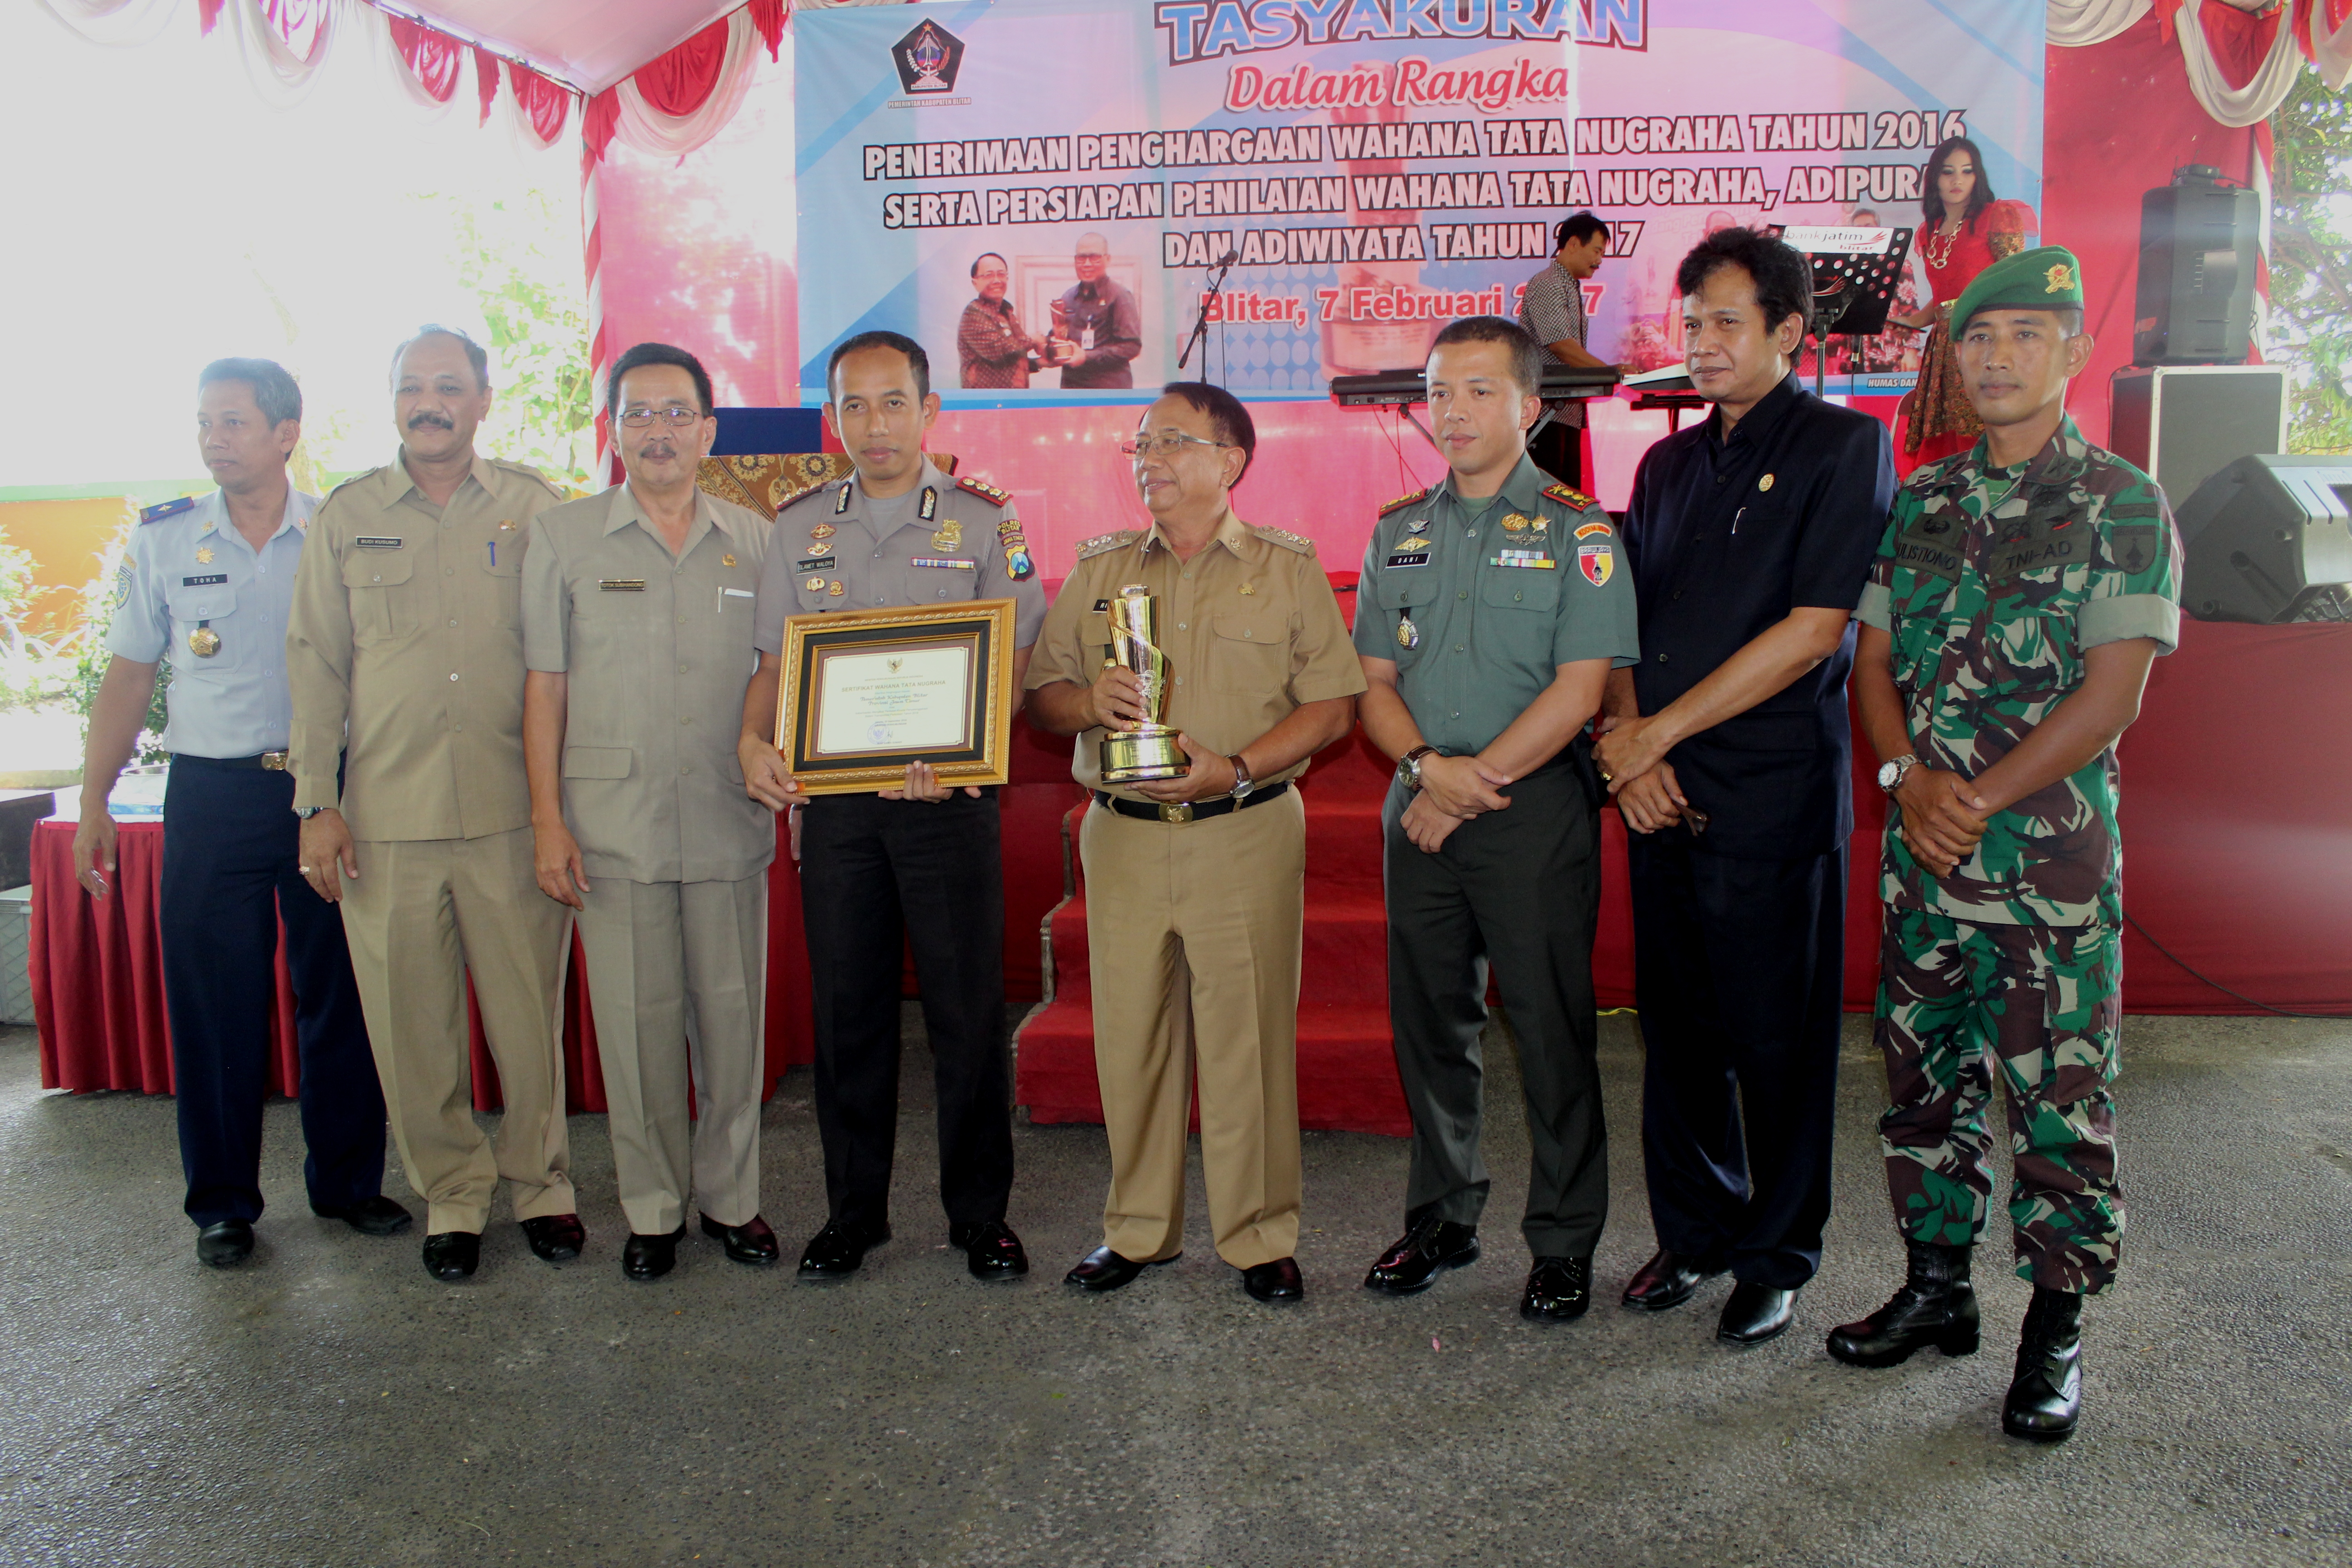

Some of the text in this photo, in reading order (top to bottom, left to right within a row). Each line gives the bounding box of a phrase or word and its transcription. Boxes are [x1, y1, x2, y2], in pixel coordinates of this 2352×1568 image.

[1156, 0, 1647, 65] TASYAKURAN
[1228, 56, 1570, 111] Dalam Rangka
[888, 100, 921, 108] PEMERINTAH
[921, 98, 951, 107] KABUPATEN
[863, 109, 1967, 181] PENERIMAAN PENGHARGAAN WAHANA TATA NUGRAHA TAHUN 2016
[883, 190, 982, 229] SERTA
[987, 182, 1164, 225] PERSIAPAN
[1172, 176, 1346, 217] PENILAIAN
[1352, 171, 1504, 211] WAHANA
[1508, 170, 1592, 208] TATA
[1599, 167, 1781, 211] NUGRAHA,
[1163, 230, 1233, 268] DAN
[1239, 225, 1427, 266] ADIWIYATA
[1430, 222, 1546, 260] TAHUN
[1199, 289, 1308, 328] Blitar,
[1317, 289, 1339, 321] 7
[1351, 284, 1504, 320] Februari
[1867, 378, 1918, 388] HUMAS DAN
[997, 520, 1020, 532] POLRES
[1001, 525, 1019, 534] BLITAR
[1897, 543, 1958, 570] ULISTIONO
[2005, 540, 2073, 570] TNI-AD
